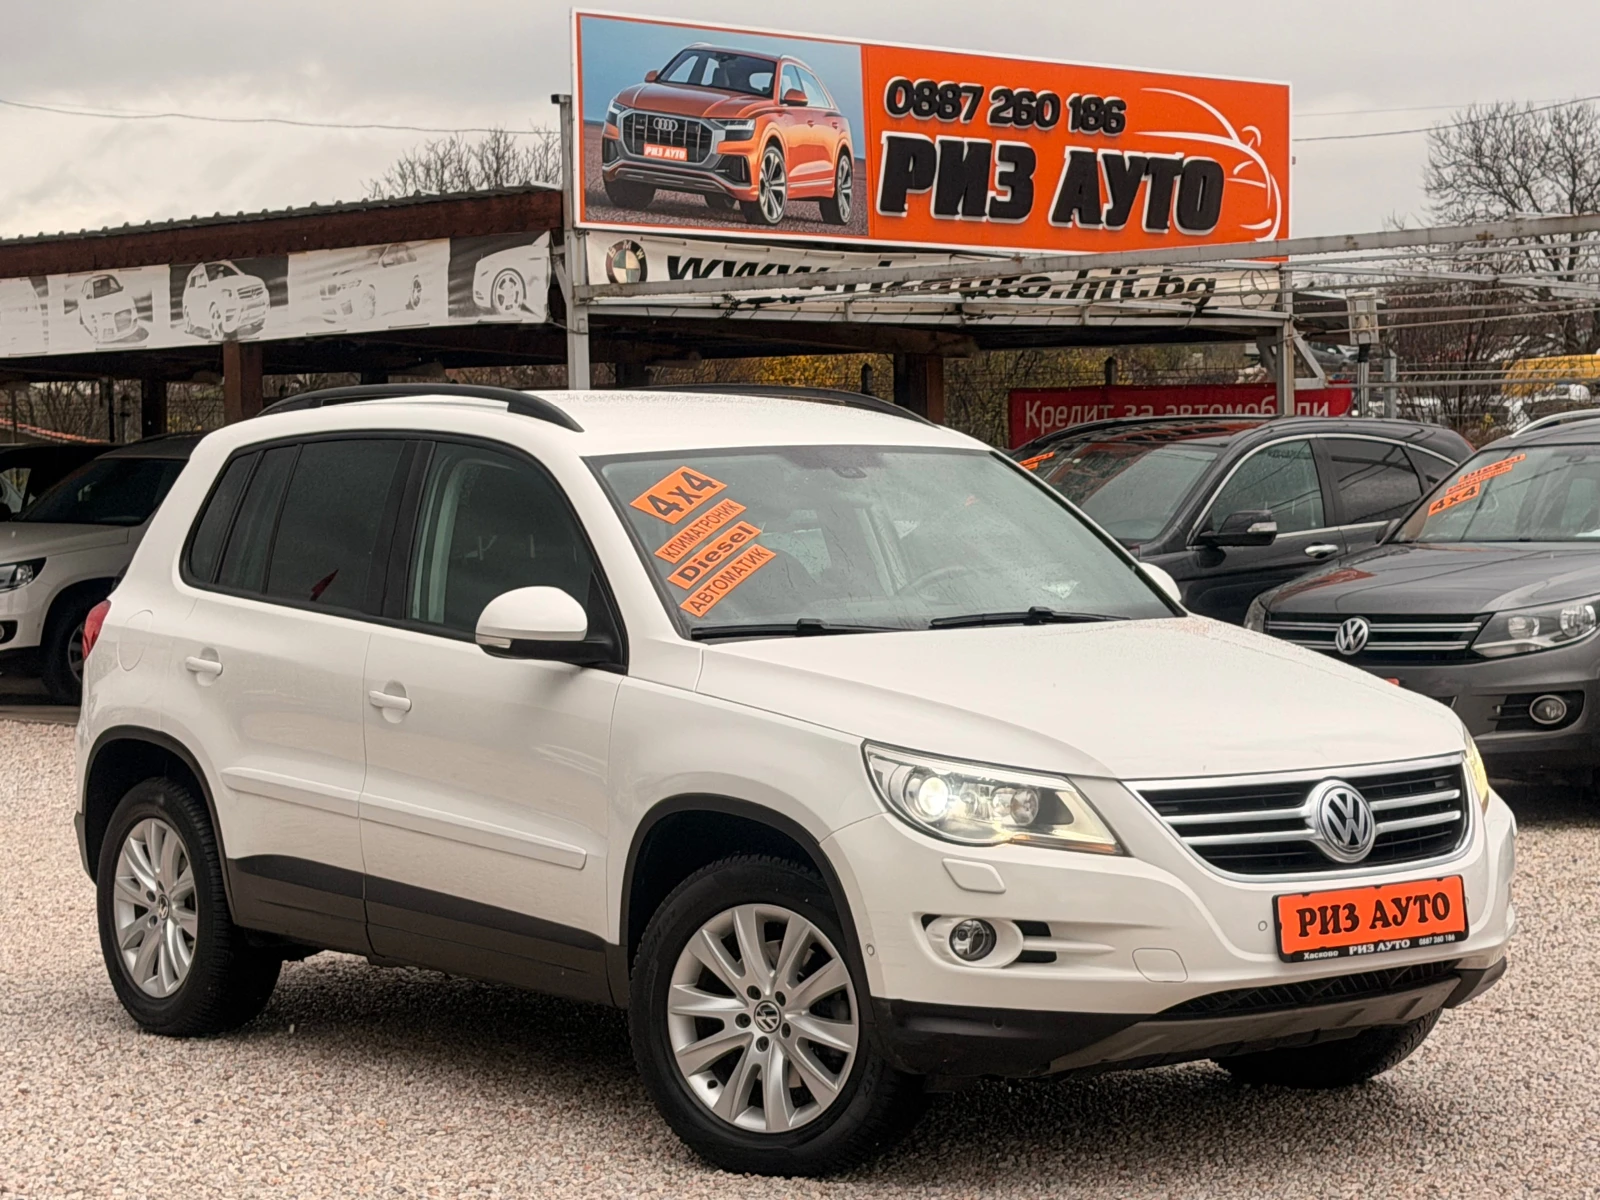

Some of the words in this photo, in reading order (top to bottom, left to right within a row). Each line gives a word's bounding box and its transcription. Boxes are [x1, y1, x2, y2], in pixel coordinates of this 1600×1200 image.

[884, 76, 984, 122] 0887
[988, 86, 1060, 131] 260
[1067, 93, 1126, 135] 186
[645, 146, 663, 157] РИЗ
[664, 148, 686, 160] АУТО
[877, 132, 1037, 222] РИЗ
[1049, 146, 1225, 235] АУТО
[1025, 400, 1114, 434] Кредит
[1165, 395, 1329, 417] автомобли
[662, 501, 740, 559] КЛИМАТРОНИК
[677, 525, 754, 582] Diesel
[689, 547, 769, 612] АВТОМАТИК
[1296, 903, 1360, 938] РИЗ
[1369, 891, 1450, 930] АУТО
[1303, 950, 1339, 960] Хасково
[1349, 944, 1374, 955] РИЗ
[1377, 939, 1411, 952] АУТО
